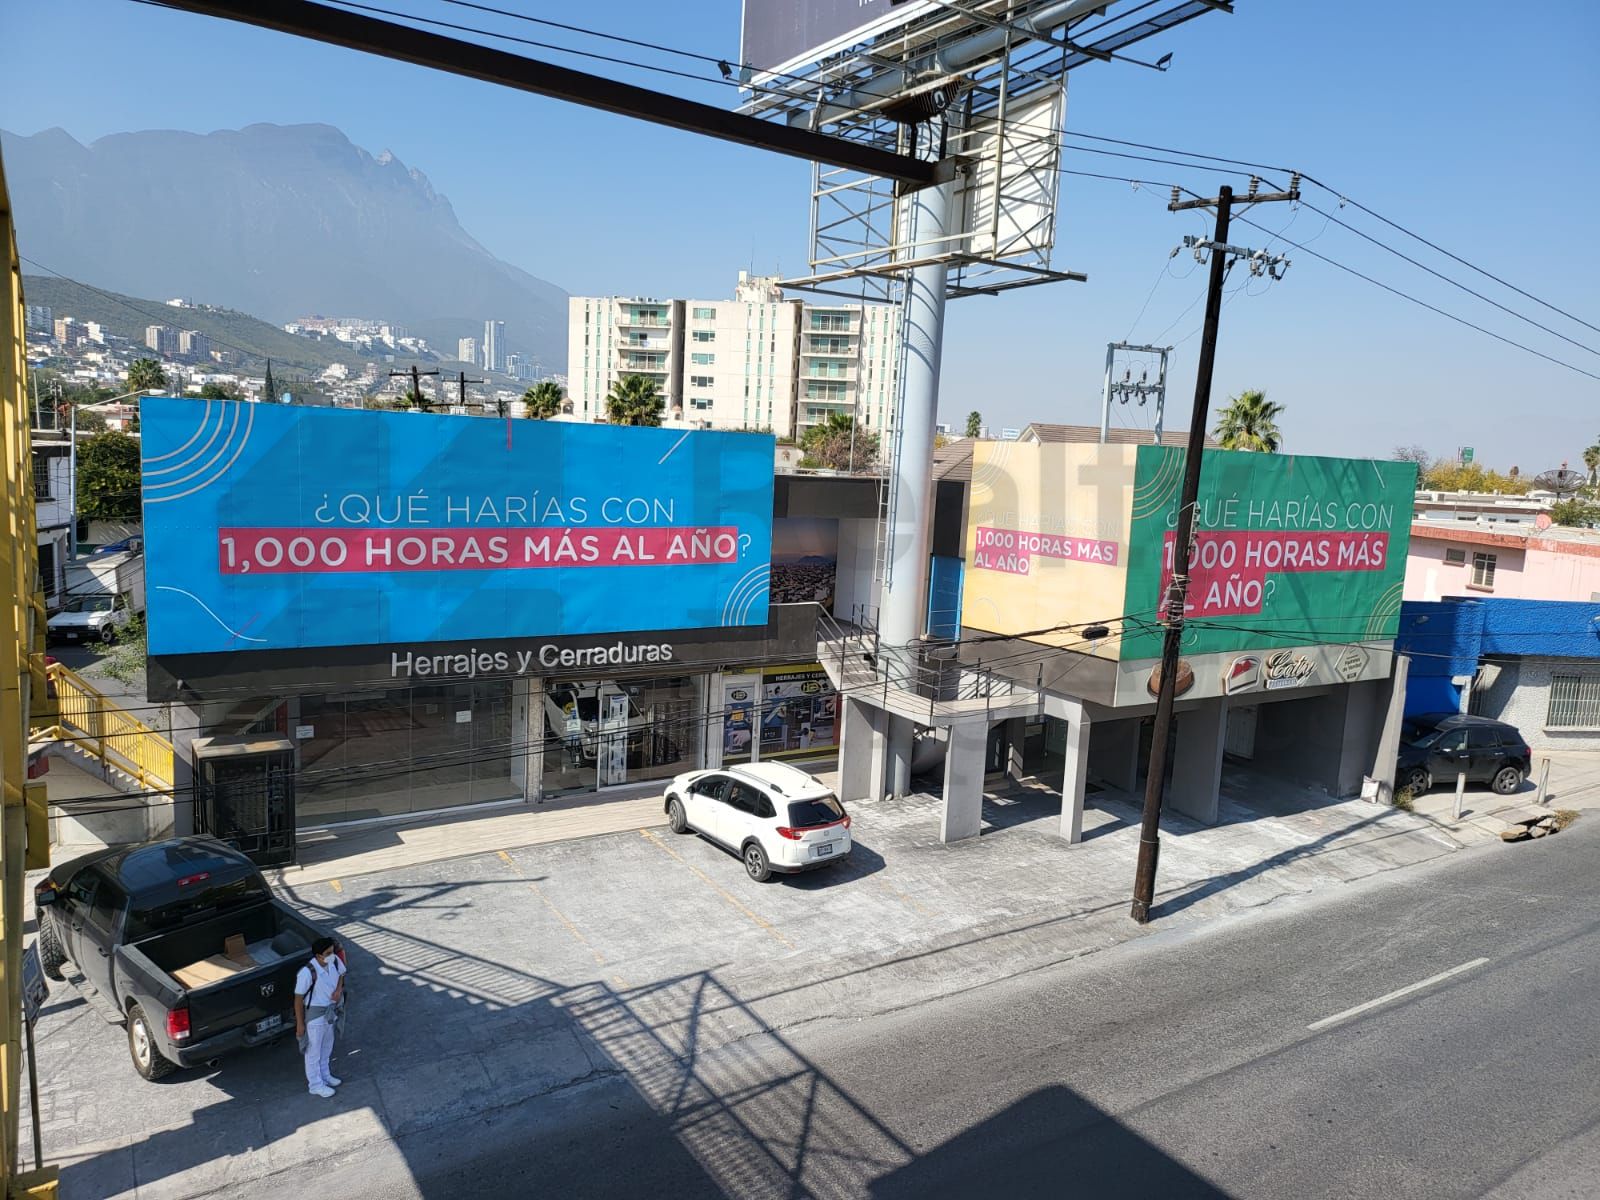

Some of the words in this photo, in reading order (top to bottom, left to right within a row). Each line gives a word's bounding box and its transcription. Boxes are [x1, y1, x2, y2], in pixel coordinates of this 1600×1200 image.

[314, 488, 429, 524] ¿QUÉ
[446, 489, 589, 523] HARÍAS
[601, 496, 676, 523] CON
[1167, 492, 1239, 528] ¿UÉ
[1248, 495, 1338, 529] HARÍAS
[1346, 503, 1393, 529] CON
[220, 537, 348, 573] 1,000
[365, 536, 508, 566] HORAS
[524, 527, 600, 564] MÁS
[612, 534, 656, 562] AL
[667, 527, 753, 561] AÑO?
[975, 551, 992, 568] AL
[976, 530, 1014, 548] 1,000
[1018, 535, 1072, 556] HORAS
[1077, 540, 1114, 562] MÁS
[1245, 540, 1330, 568] HORAS
[1337, 533, 1384, 567] MÁS
[1203, 573, 1276, 610] AÑO?
[391, 648, 509, 678] Herrajes
[517, 651, 533, 674] y
[540, 641, 673, 671] Cerraduras
[1268, 650, 1319, 687] Caty
